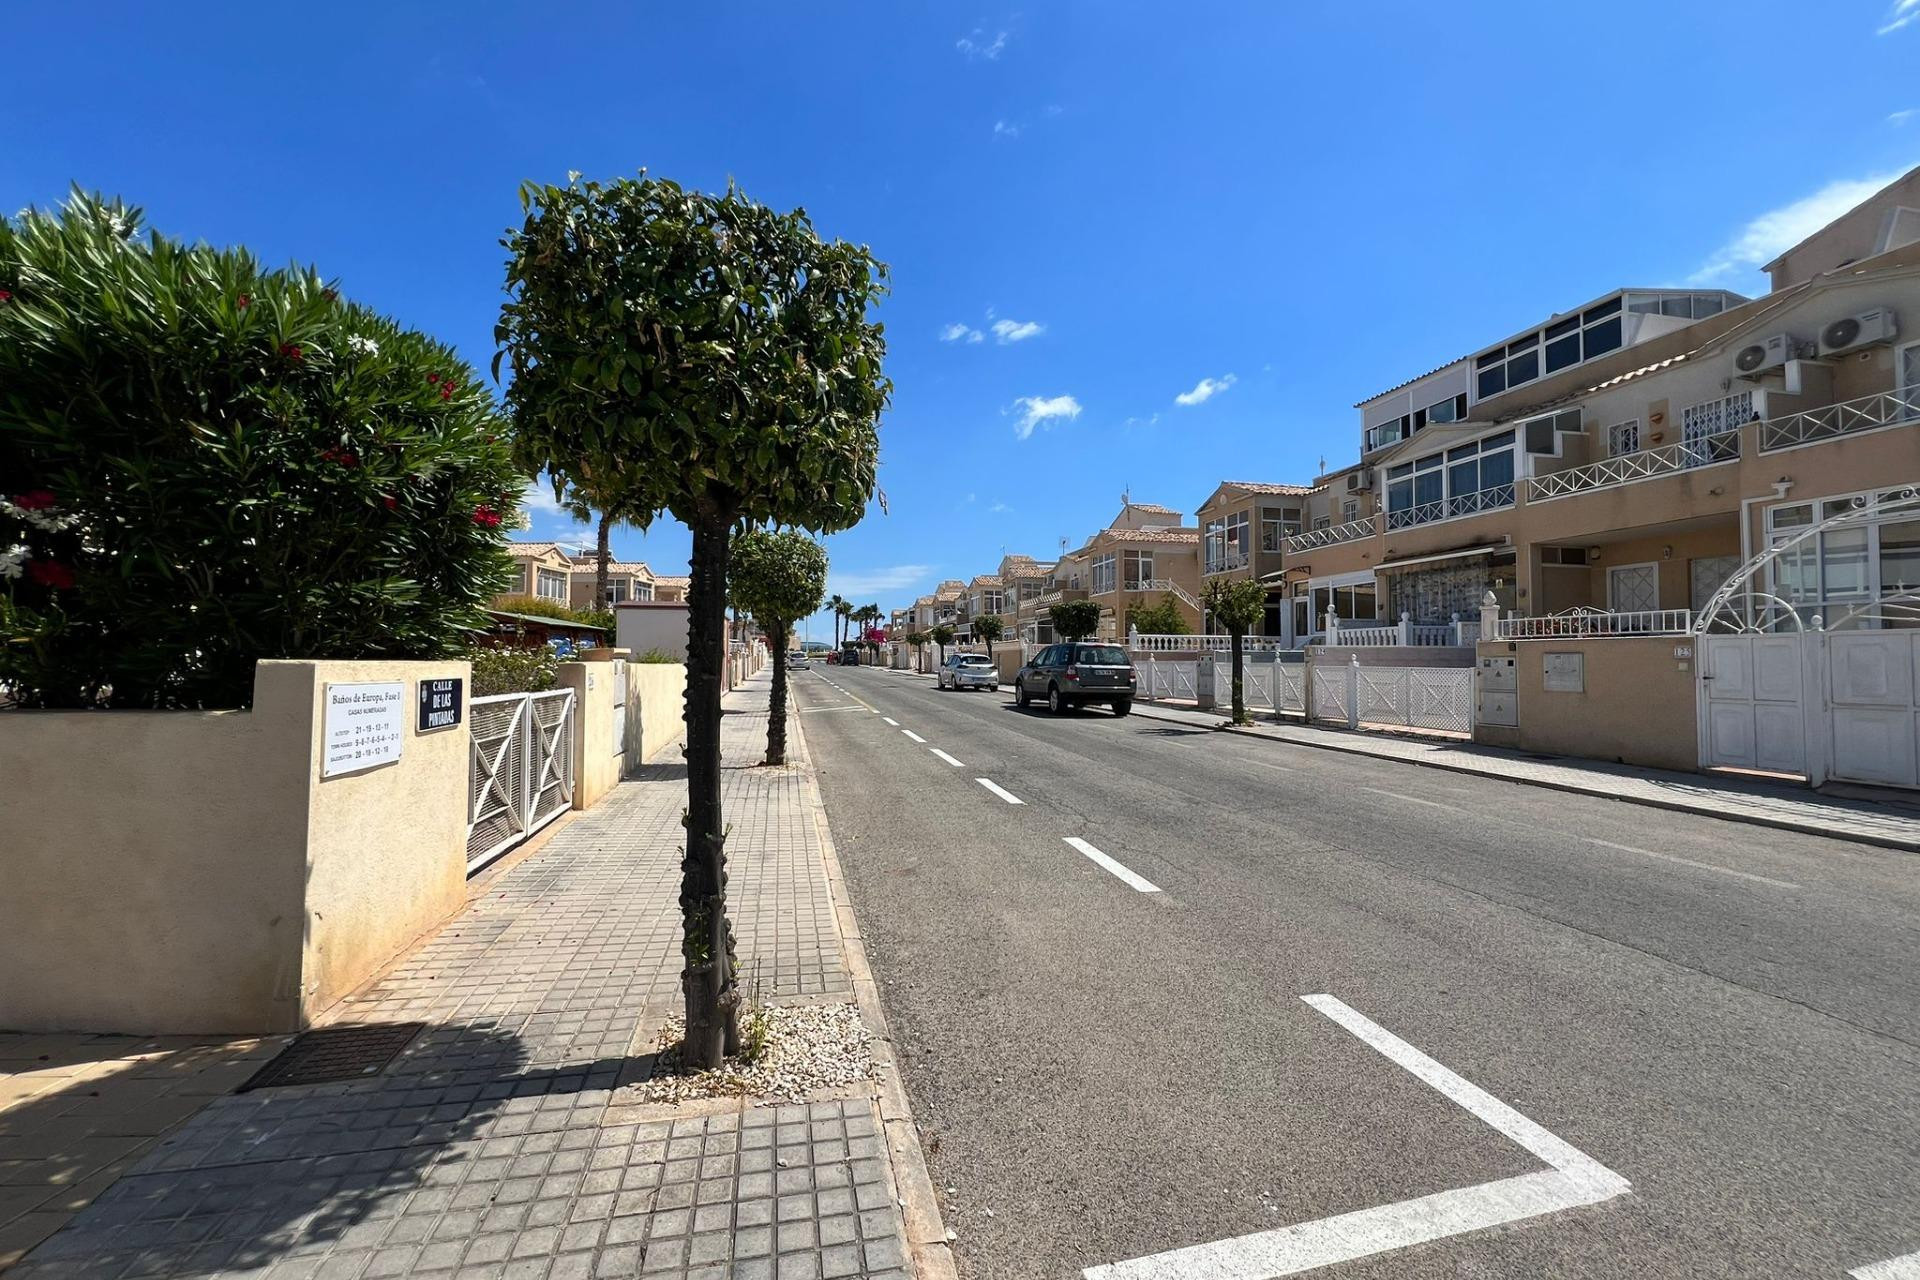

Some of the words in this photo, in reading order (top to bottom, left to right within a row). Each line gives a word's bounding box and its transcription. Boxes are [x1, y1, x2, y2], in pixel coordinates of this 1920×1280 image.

[433, 681, 453, 692] CALLE
[332, 695, 352, 705] Baños
[353, 693, 361, 703] de
[362, 693, 384, 704] Europa,
[385, 692, 397, 701] Fase
[433, 694, 441, 709] DE
[441, 693, 452, 707] LAS
[428, 709, 455, 728] PINTADAS
